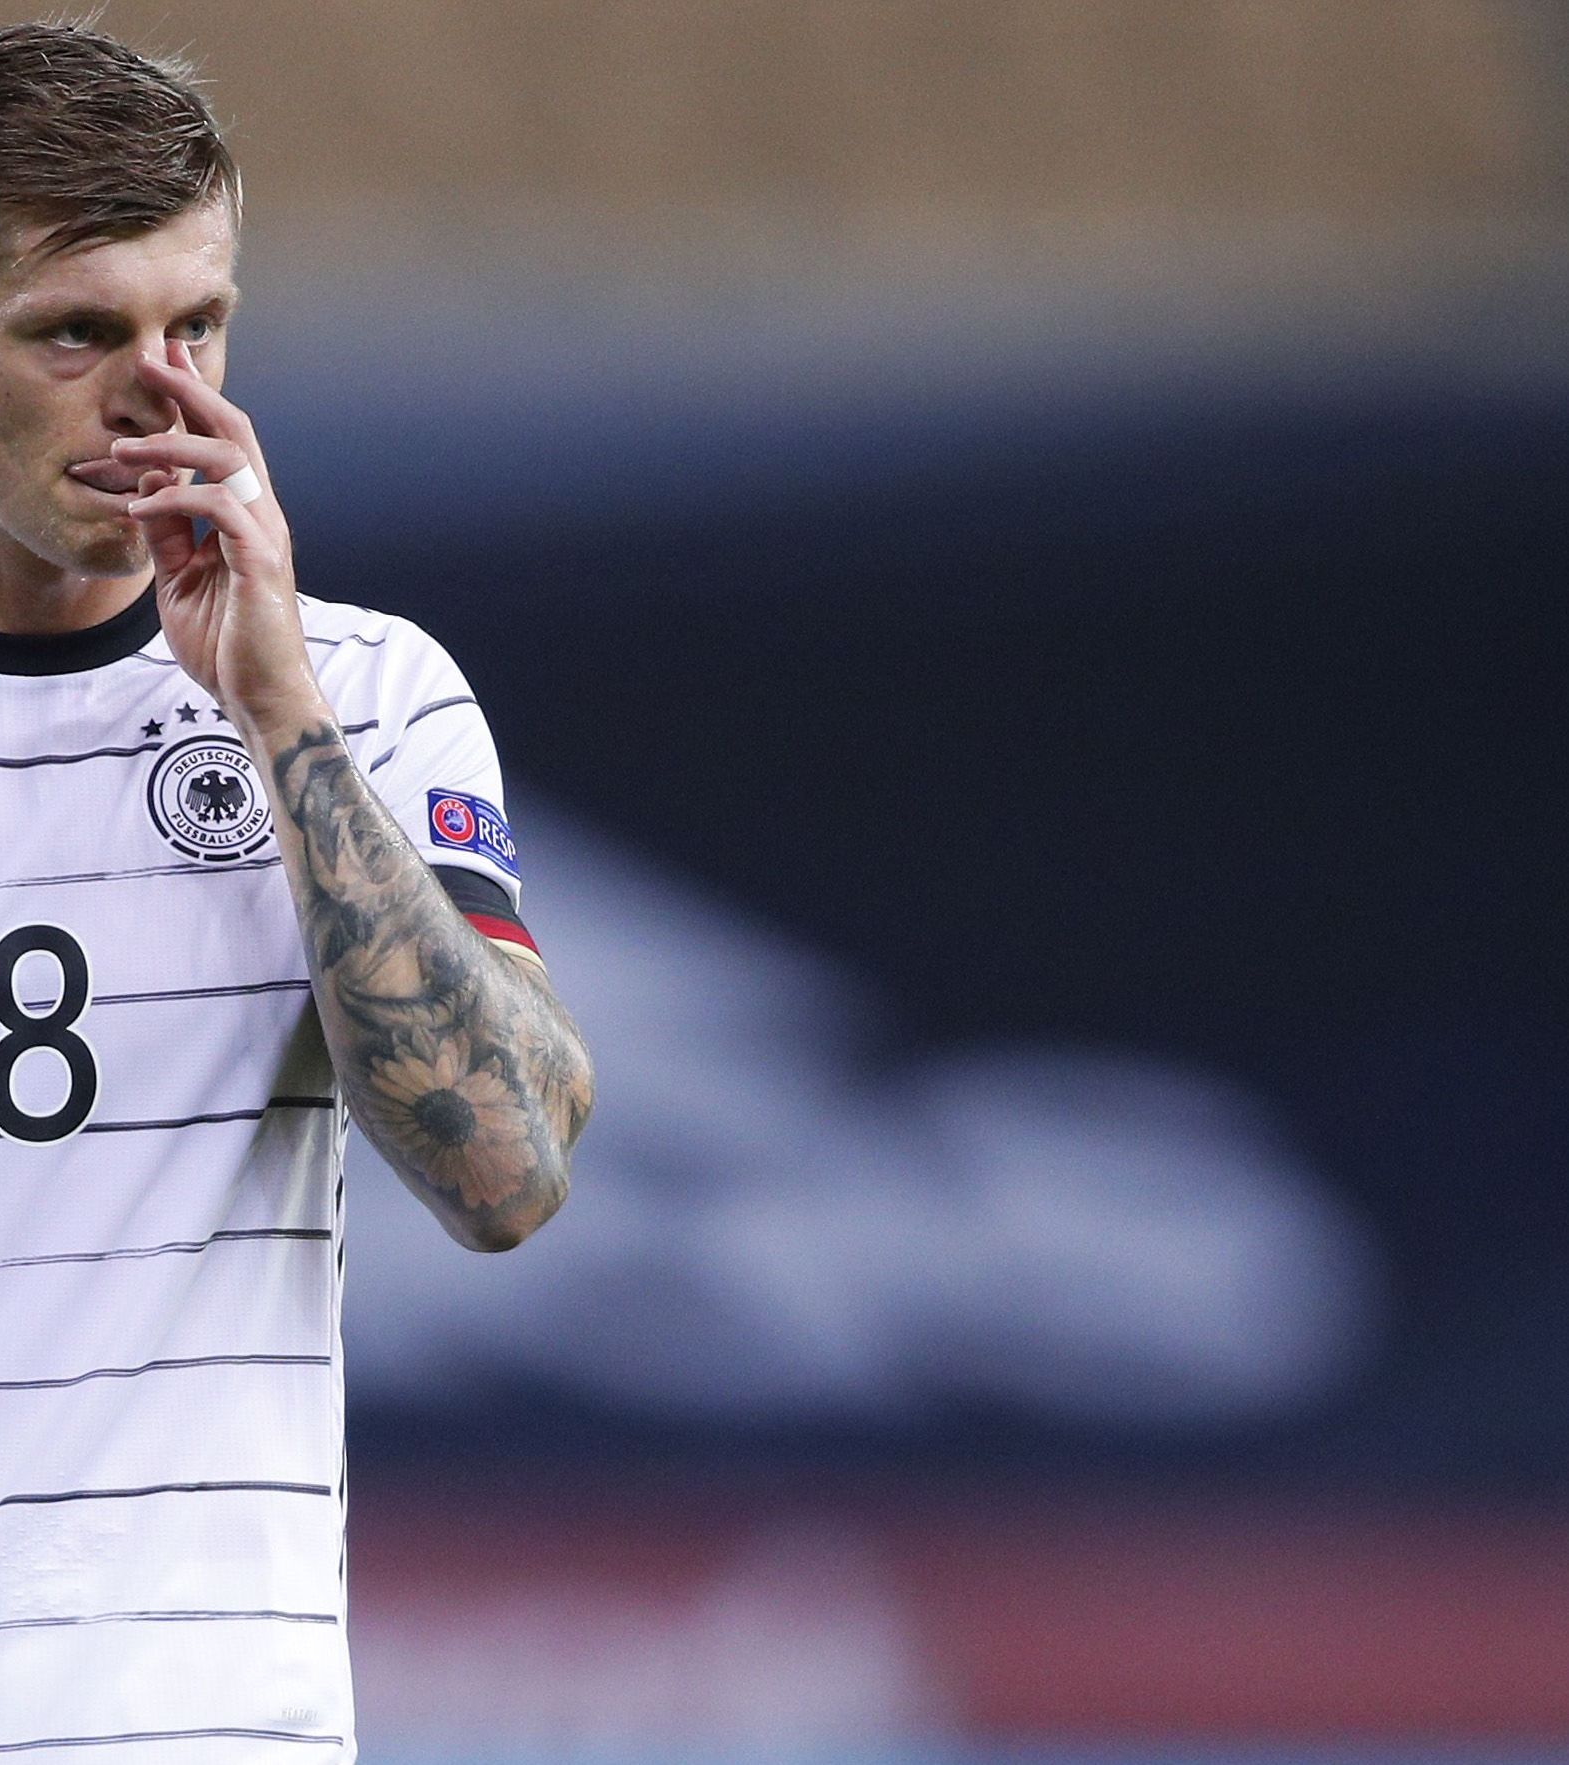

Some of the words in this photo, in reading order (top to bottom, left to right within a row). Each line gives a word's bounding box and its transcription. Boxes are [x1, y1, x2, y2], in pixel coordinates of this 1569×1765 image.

[174, 751, 250, 775] DEUTSCHER
[440, 801, 466, 813] UEFA
[171, 808, 264, 844] FUSSBALL-BUND
